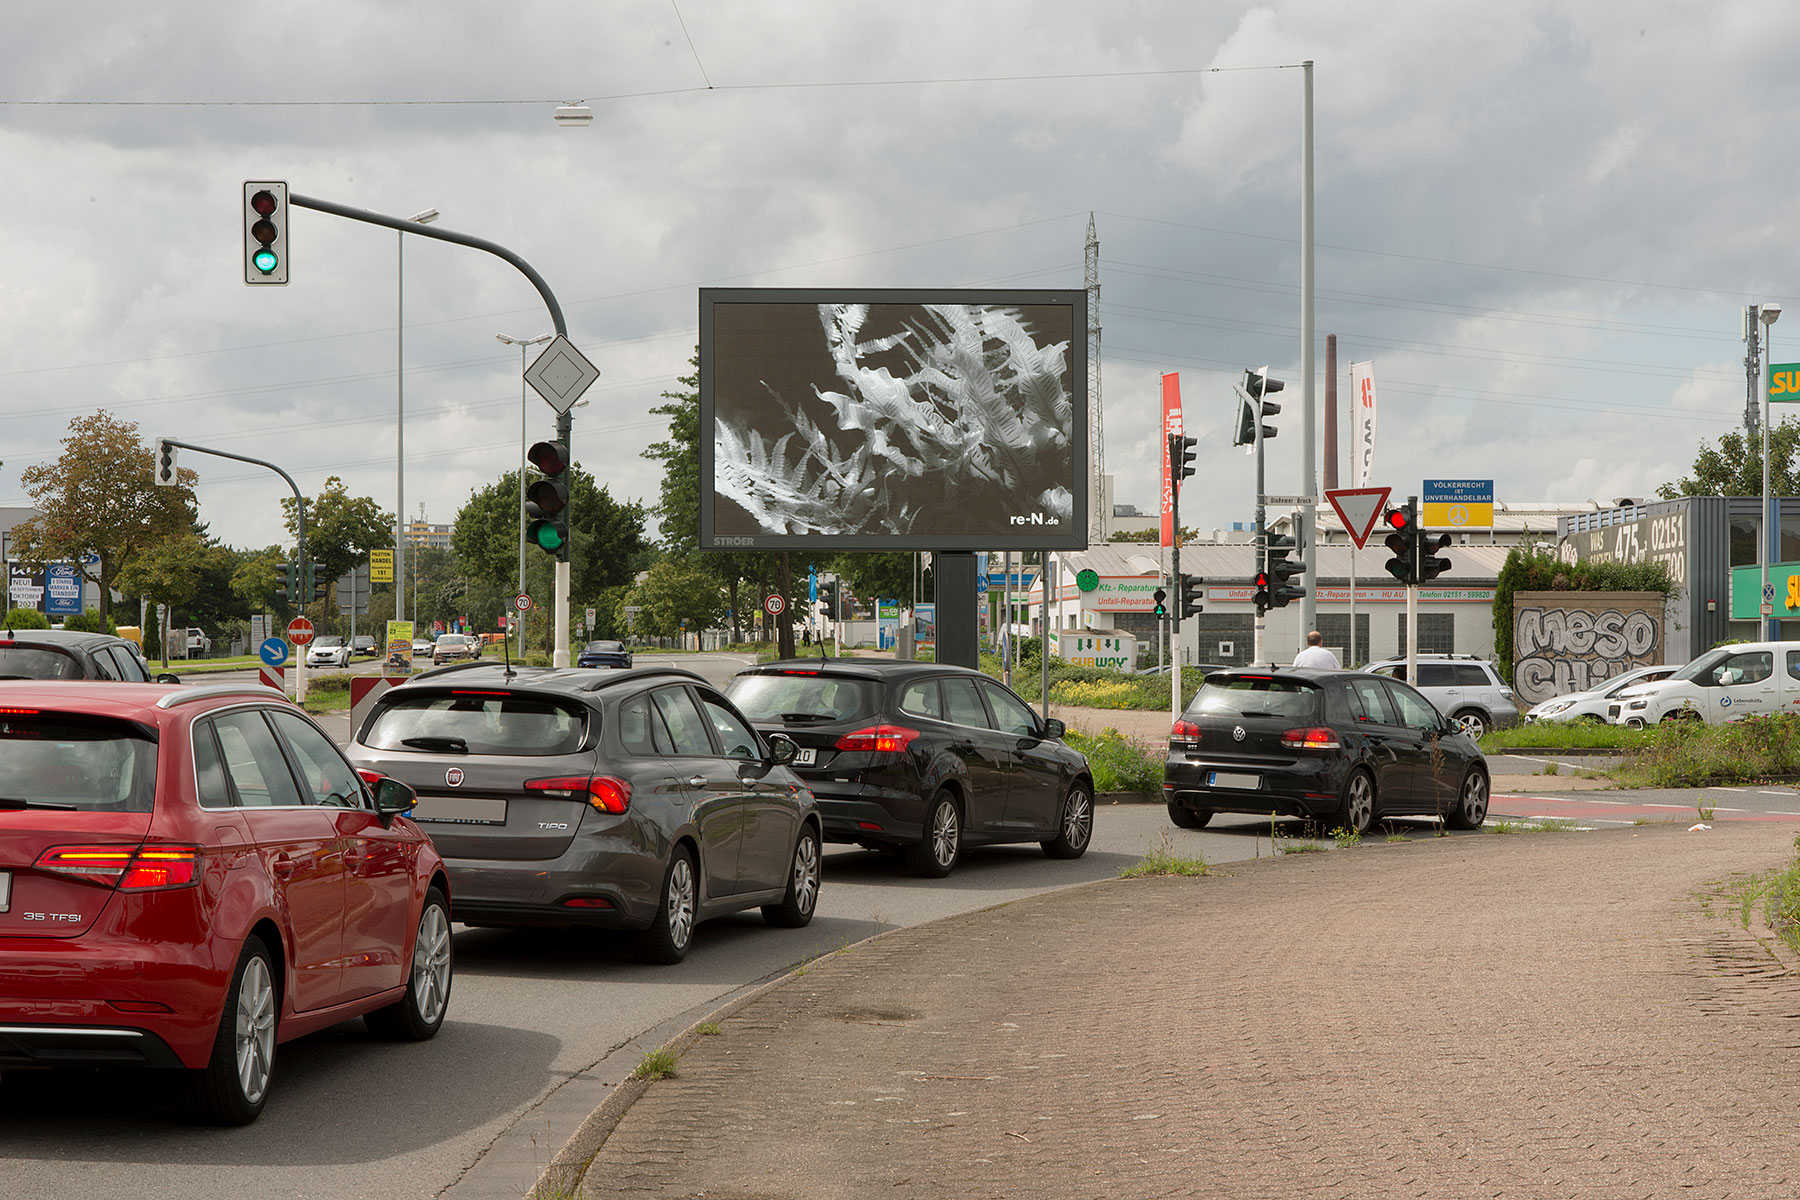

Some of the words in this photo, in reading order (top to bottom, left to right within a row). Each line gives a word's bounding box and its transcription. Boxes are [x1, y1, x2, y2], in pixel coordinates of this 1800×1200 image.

[1433, 481, 1486, 489] VÖLKERRECHT
[1652, 515, 1684, 551] 02151
[714, 537, 754, 546] STRÖER
[519, 599, 527, 607] 70
[770, 600, 780, 609] 70
[449, 773, 460, 782] FIAT
[24, 912, 45, 920] 35
[49, 913, 81, 922] TFSI
